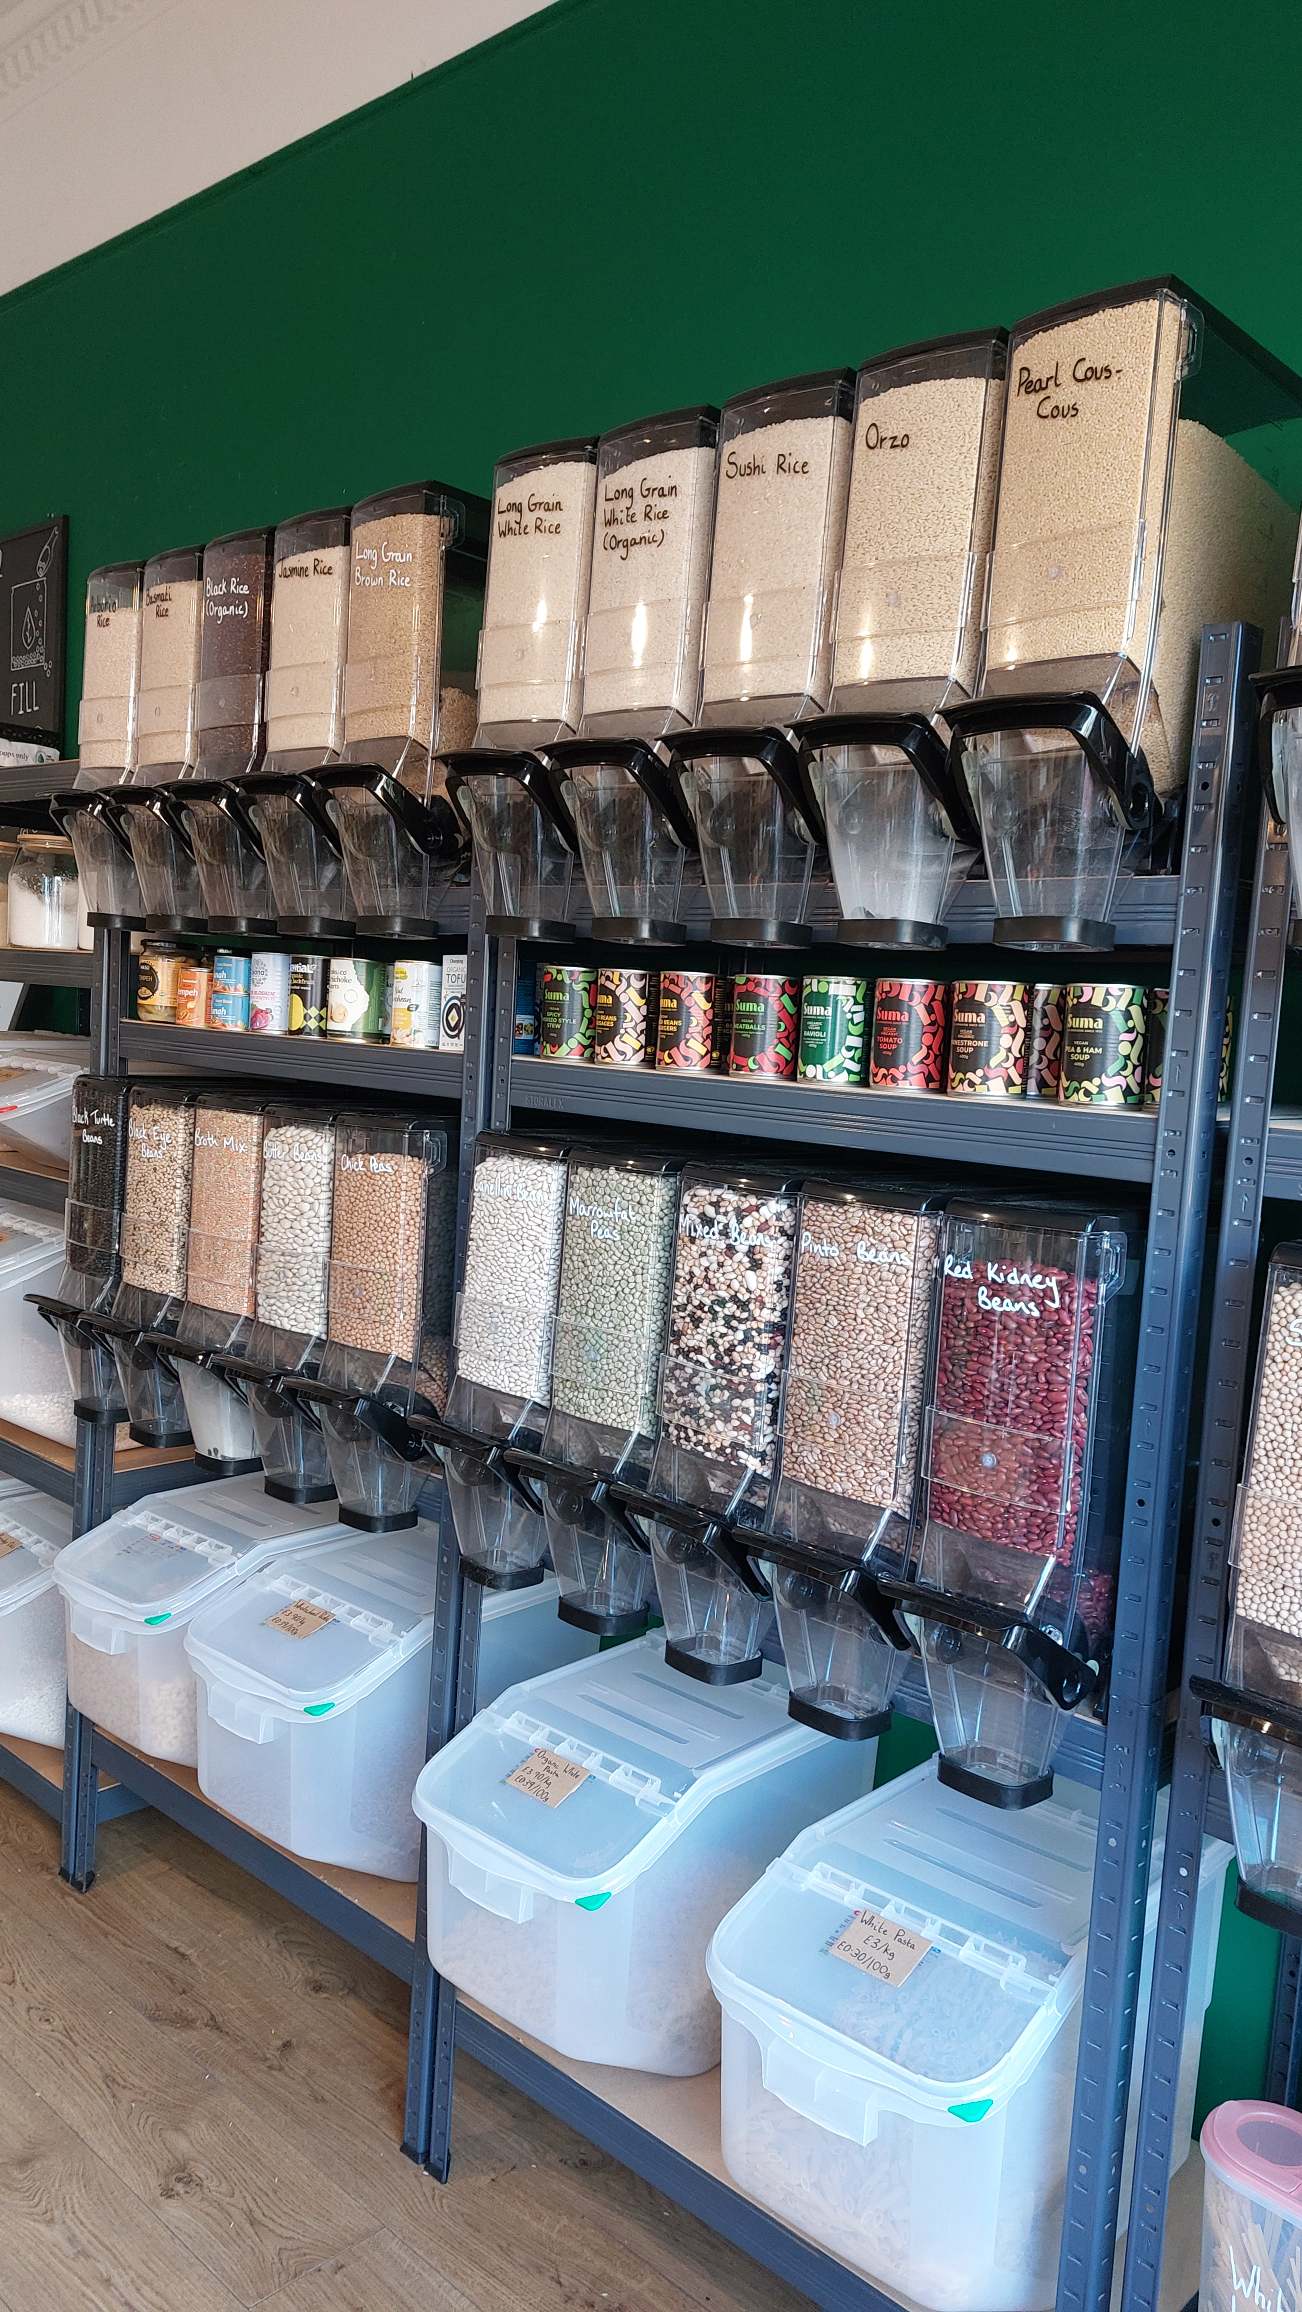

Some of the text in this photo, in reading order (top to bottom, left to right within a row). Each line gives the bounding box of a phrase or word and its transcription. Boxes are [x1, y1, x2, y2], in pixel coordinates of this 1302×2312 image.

[1017, 357, 1123, 396] Pearl Cous-
[1036, 396, 1079, 419] Cous
[865, 423, 910, 450] Orzo
[725, 452, 809, 479] Sushi Rice
[605, 475, 677, 509] Long Grain
[497, 493, 563, 524] Long Grain
[603, 504, 669, 527] White Rice
[498, 517, 561, 538] White Rice
[356, 541, 413, 569] Long Grain
[603, 528, 665, 560] (Organic)
[278, 557, 333, 578] Jasmine Rice
[354, 566, 411, 587] Brown Rice
[206, 576, 250, 597] Black Rice
[97, 614, 111, 628] Rice
[155, 605, 169, 618] Rice
[205, 600, 248, 624] (Organic)
[11, 681, 39, 715] FILL
[544, 991, 570, 1001] Suma
[735, 999, 765, 1012] Suma
[803, 1003, 833, 1017] Suma
[876, 1007, 909, 1021] Suma
[953, 1008, 986, 1023] Suma
[1066, 1013, 1104, 1029] Suma
[90, 1109, 116, 1127] Turtle
[82, 1129, 103, 1145] Beans
[153, 1126, 172, 1150] Eye
[194, 1129, 248, 1153] Broth Mix
[141, 1142, 163, 1158] Beans
[293, 1143, 323, 1162] Beans
[341, 1153, 395, 1174] Chick Peas
[569, 1196, 637, 1223] Marrowfat
[590, 1220, 620, 1241] Peas
[679, 1213, 772, 1248] Mixed Beans
[801, 1231, 913, 1266] Pinto Beans
[943, 1254, 1060, 1309] Red Kidney
[977, 1285, 1040, 1317] Beans
[860, 1909, 916, 1951] White Pasta
